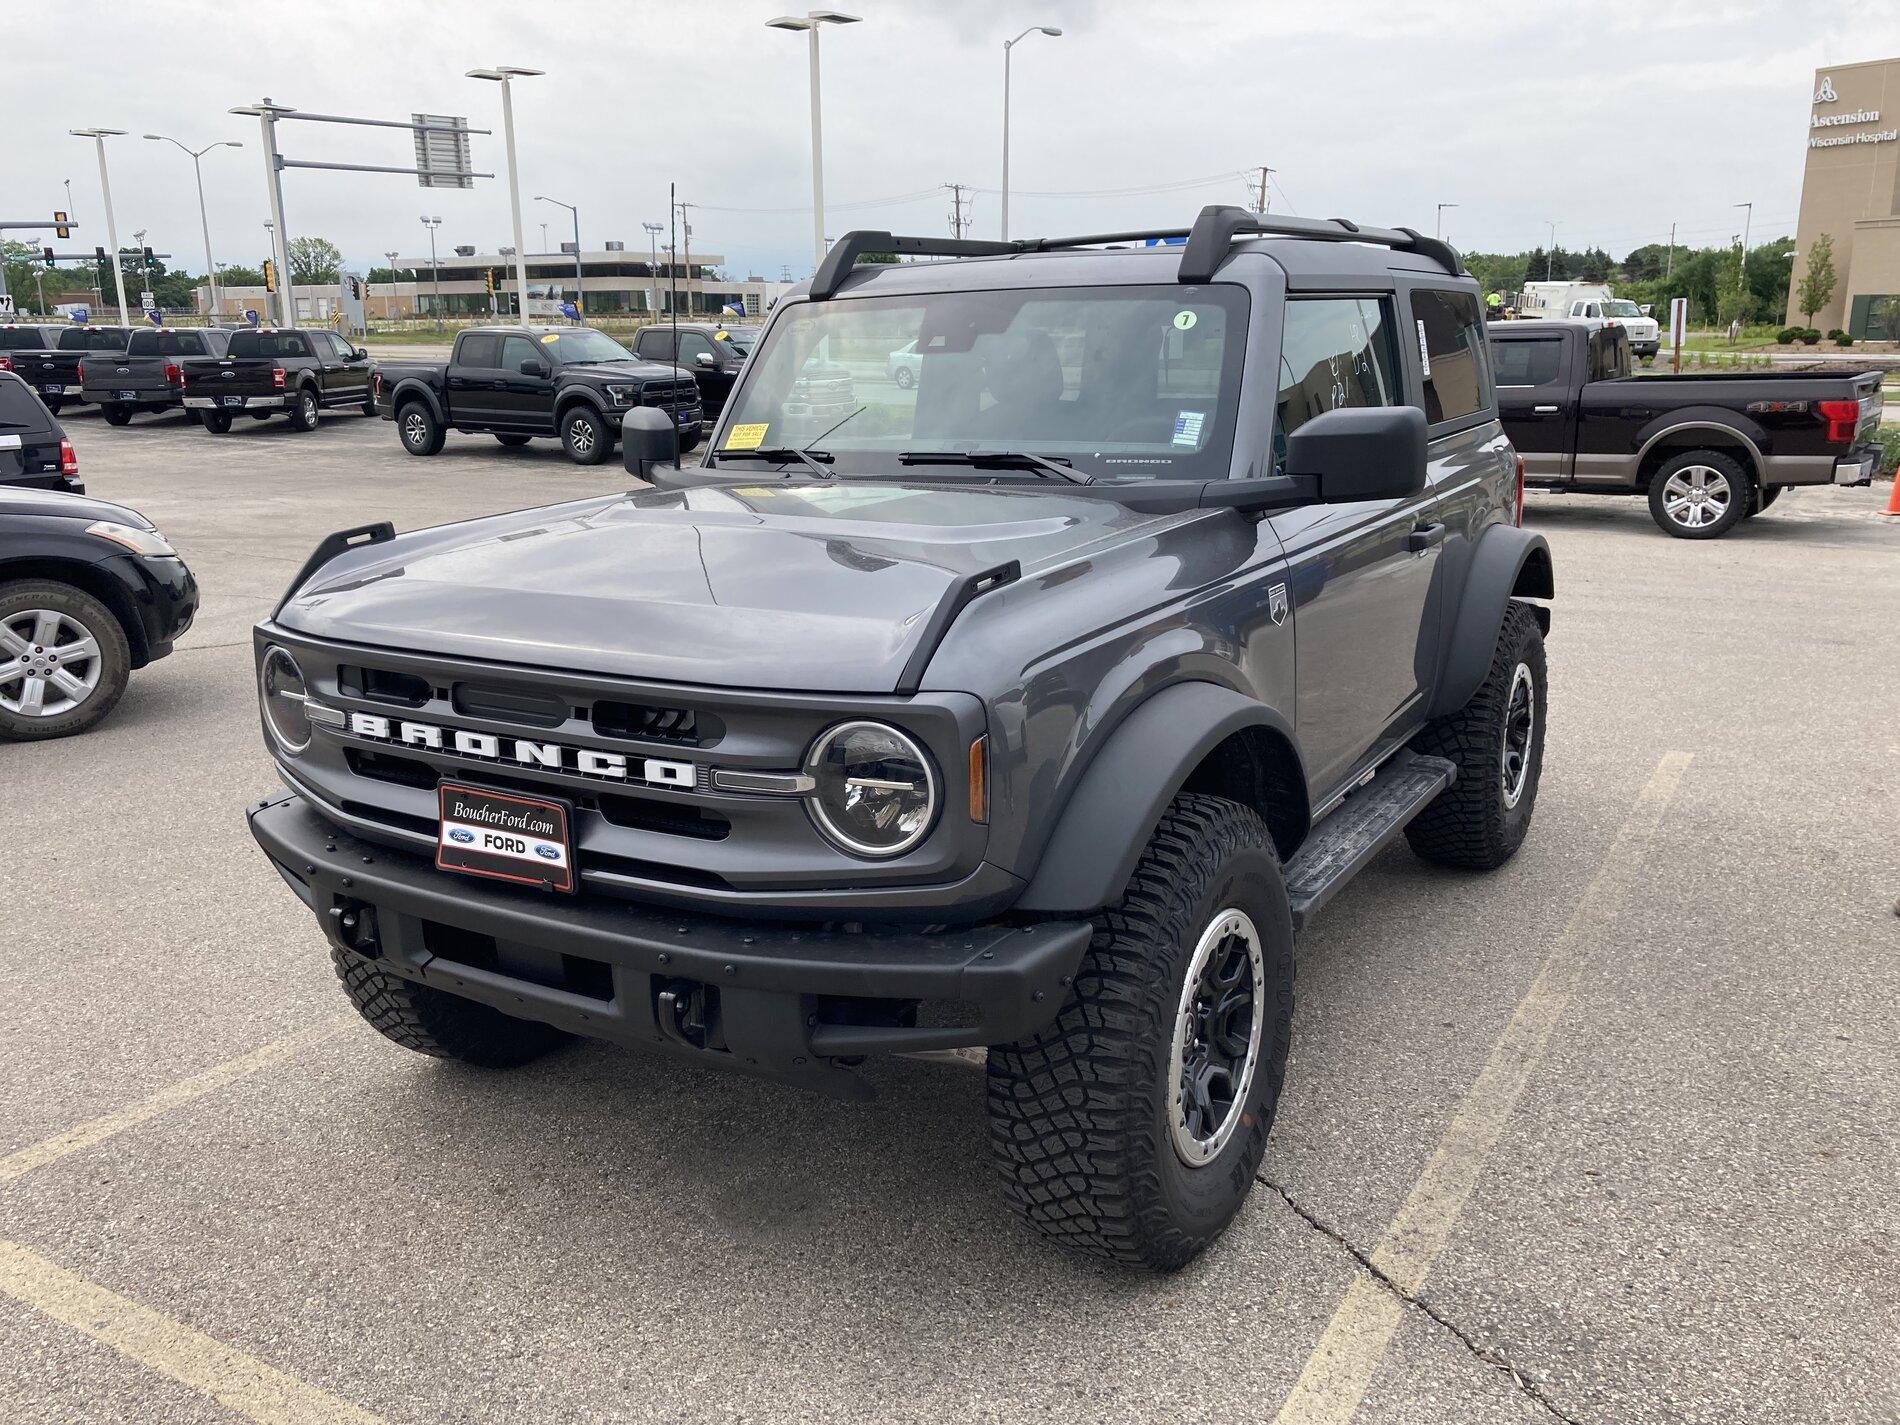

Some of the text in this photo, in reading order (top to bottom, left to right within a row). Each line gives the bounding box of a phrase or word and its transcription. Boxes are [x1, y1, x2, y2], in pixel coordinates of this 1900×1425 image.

[1811, 109, 1879, 128] Ascension
[1808, 129, 1897, 147] Wisconsin Hospital
[1183, 315, 1189, 326] 7
[351, 711, 697, 787] BRONCO
[453, 801, 554, 835] BoucherFord.com
[484, 834, 526, 854] FORD
